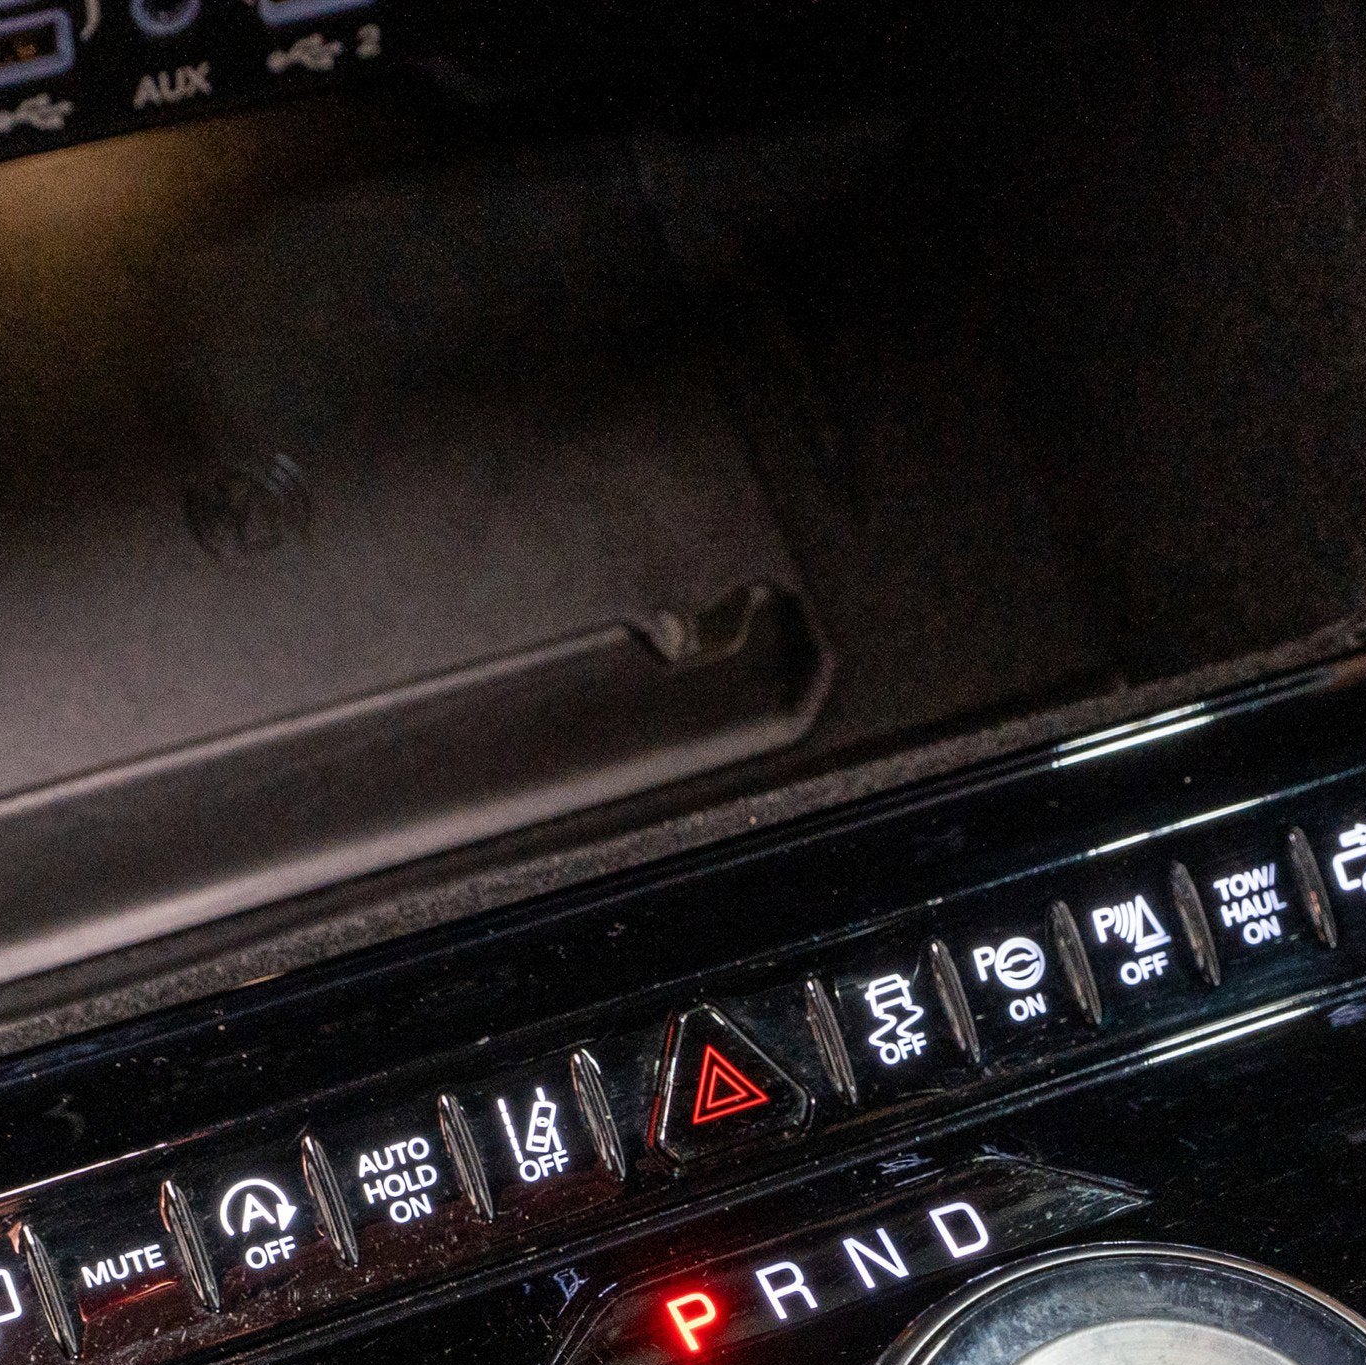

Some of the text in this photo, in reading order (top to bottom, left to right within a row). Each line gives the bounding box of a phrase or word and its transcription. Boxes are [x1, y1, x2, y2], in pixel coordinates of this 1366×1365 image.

[356, 23, 382, 59] 2
[134, 61, 212, 109] AUX
[1213, 863, 1277, 902] TOW/
[1220, 890, 1287, 928] HAUL
[1242, 916, 1282, 946] ON
[1120, 952, 1169, 986] OFF
[1008, 992, 1047, 1023] ON
[878, 1034, 927, 1065] OFF
[358, 1136, 431, 1178] AUTO
[519, 1149, 569, 1183] OFF
[363, 1165, 438, 1205] HOLD
[389, 1193, 433, 1224] ON
[80, 1243, 166, 1289] MUTE
[245, 1236, 297, 1270] OFF
[665, 1201, 990, 1352] P R N D
